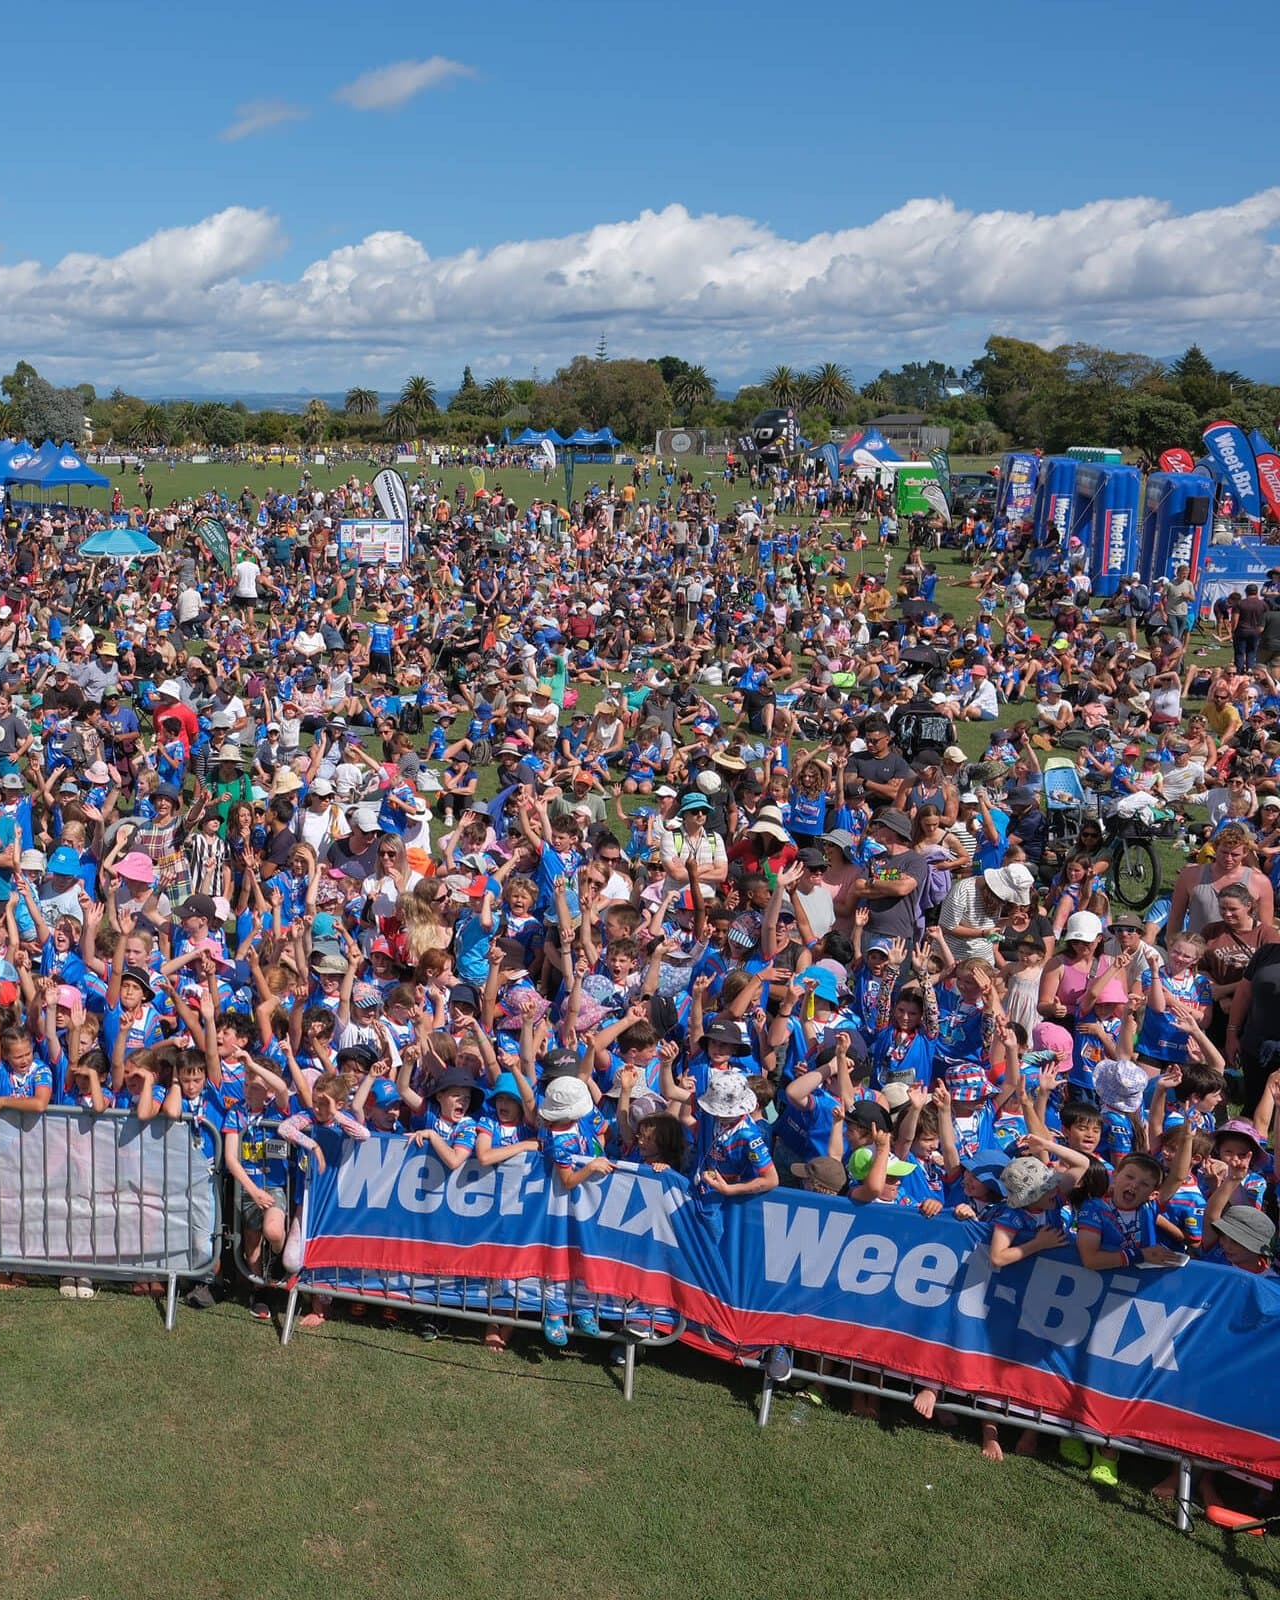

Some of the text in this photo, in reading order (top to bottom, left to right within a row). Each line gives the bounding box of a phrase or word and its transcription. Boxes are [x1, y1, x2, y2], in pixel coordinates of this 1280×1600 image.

[1214, 432, 1255, 498] Weet-Bix
[1108, 513, 1129, 570] Weet-Bix
[337, 1137, 691, 1248] Weet-Bix
[762, 1201, 1210, 1371] Weet-Bix
